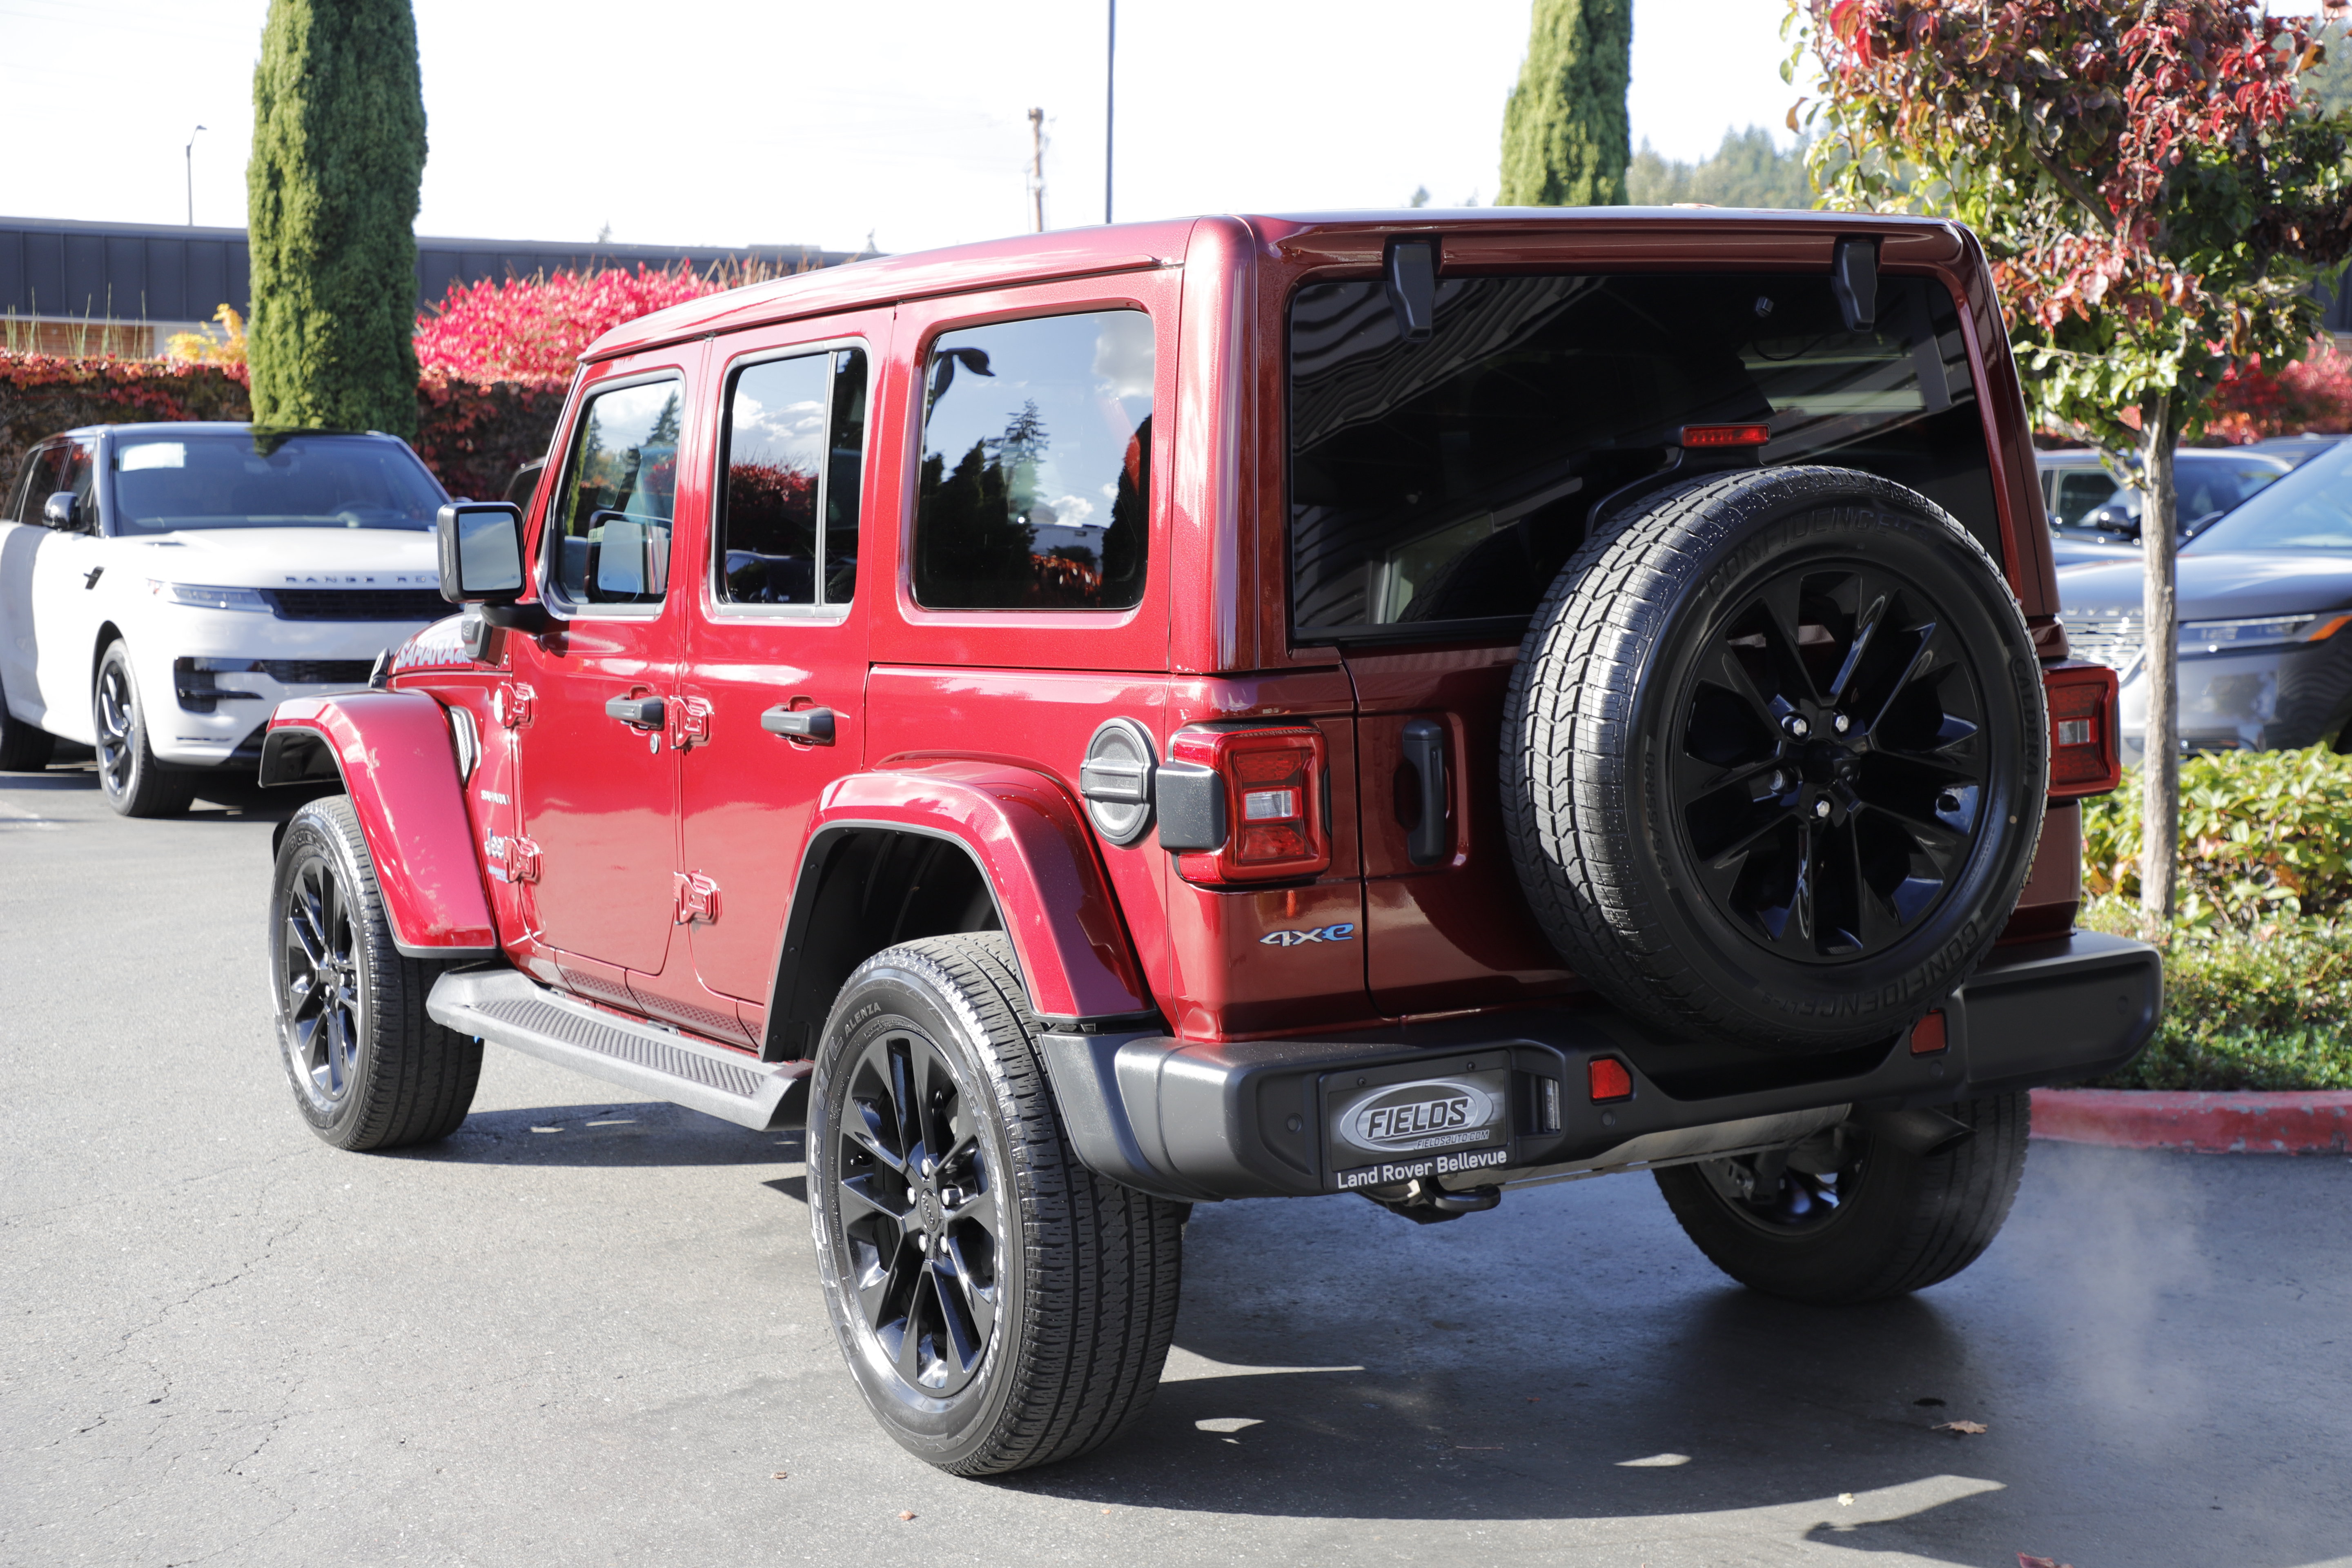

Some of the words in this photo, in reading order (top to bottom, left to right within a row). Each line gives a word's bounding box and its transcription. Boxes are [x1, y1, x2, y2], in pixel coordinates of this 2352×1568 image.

[1704, 506, 1888, 602] CONFIDENCE
[396, 639, 456, 669] SAHARA
[2013, 657, 2039, 776] CALDERA
[1116, 780, 1137, 788] FUEL
[1645, 751, 1673, 879] 275/55R20
[484, 827, 506, 860] Jee
[844, 1002, 882, 1038] ALENZA
[1367, 1097, 1469, 1139] FIELDS
[1337, 1166, 1378, 1189] Land
[1383, 1161, 1433, 1182] Rover
[1437, 1150, 1507, 1174] Bellevue
